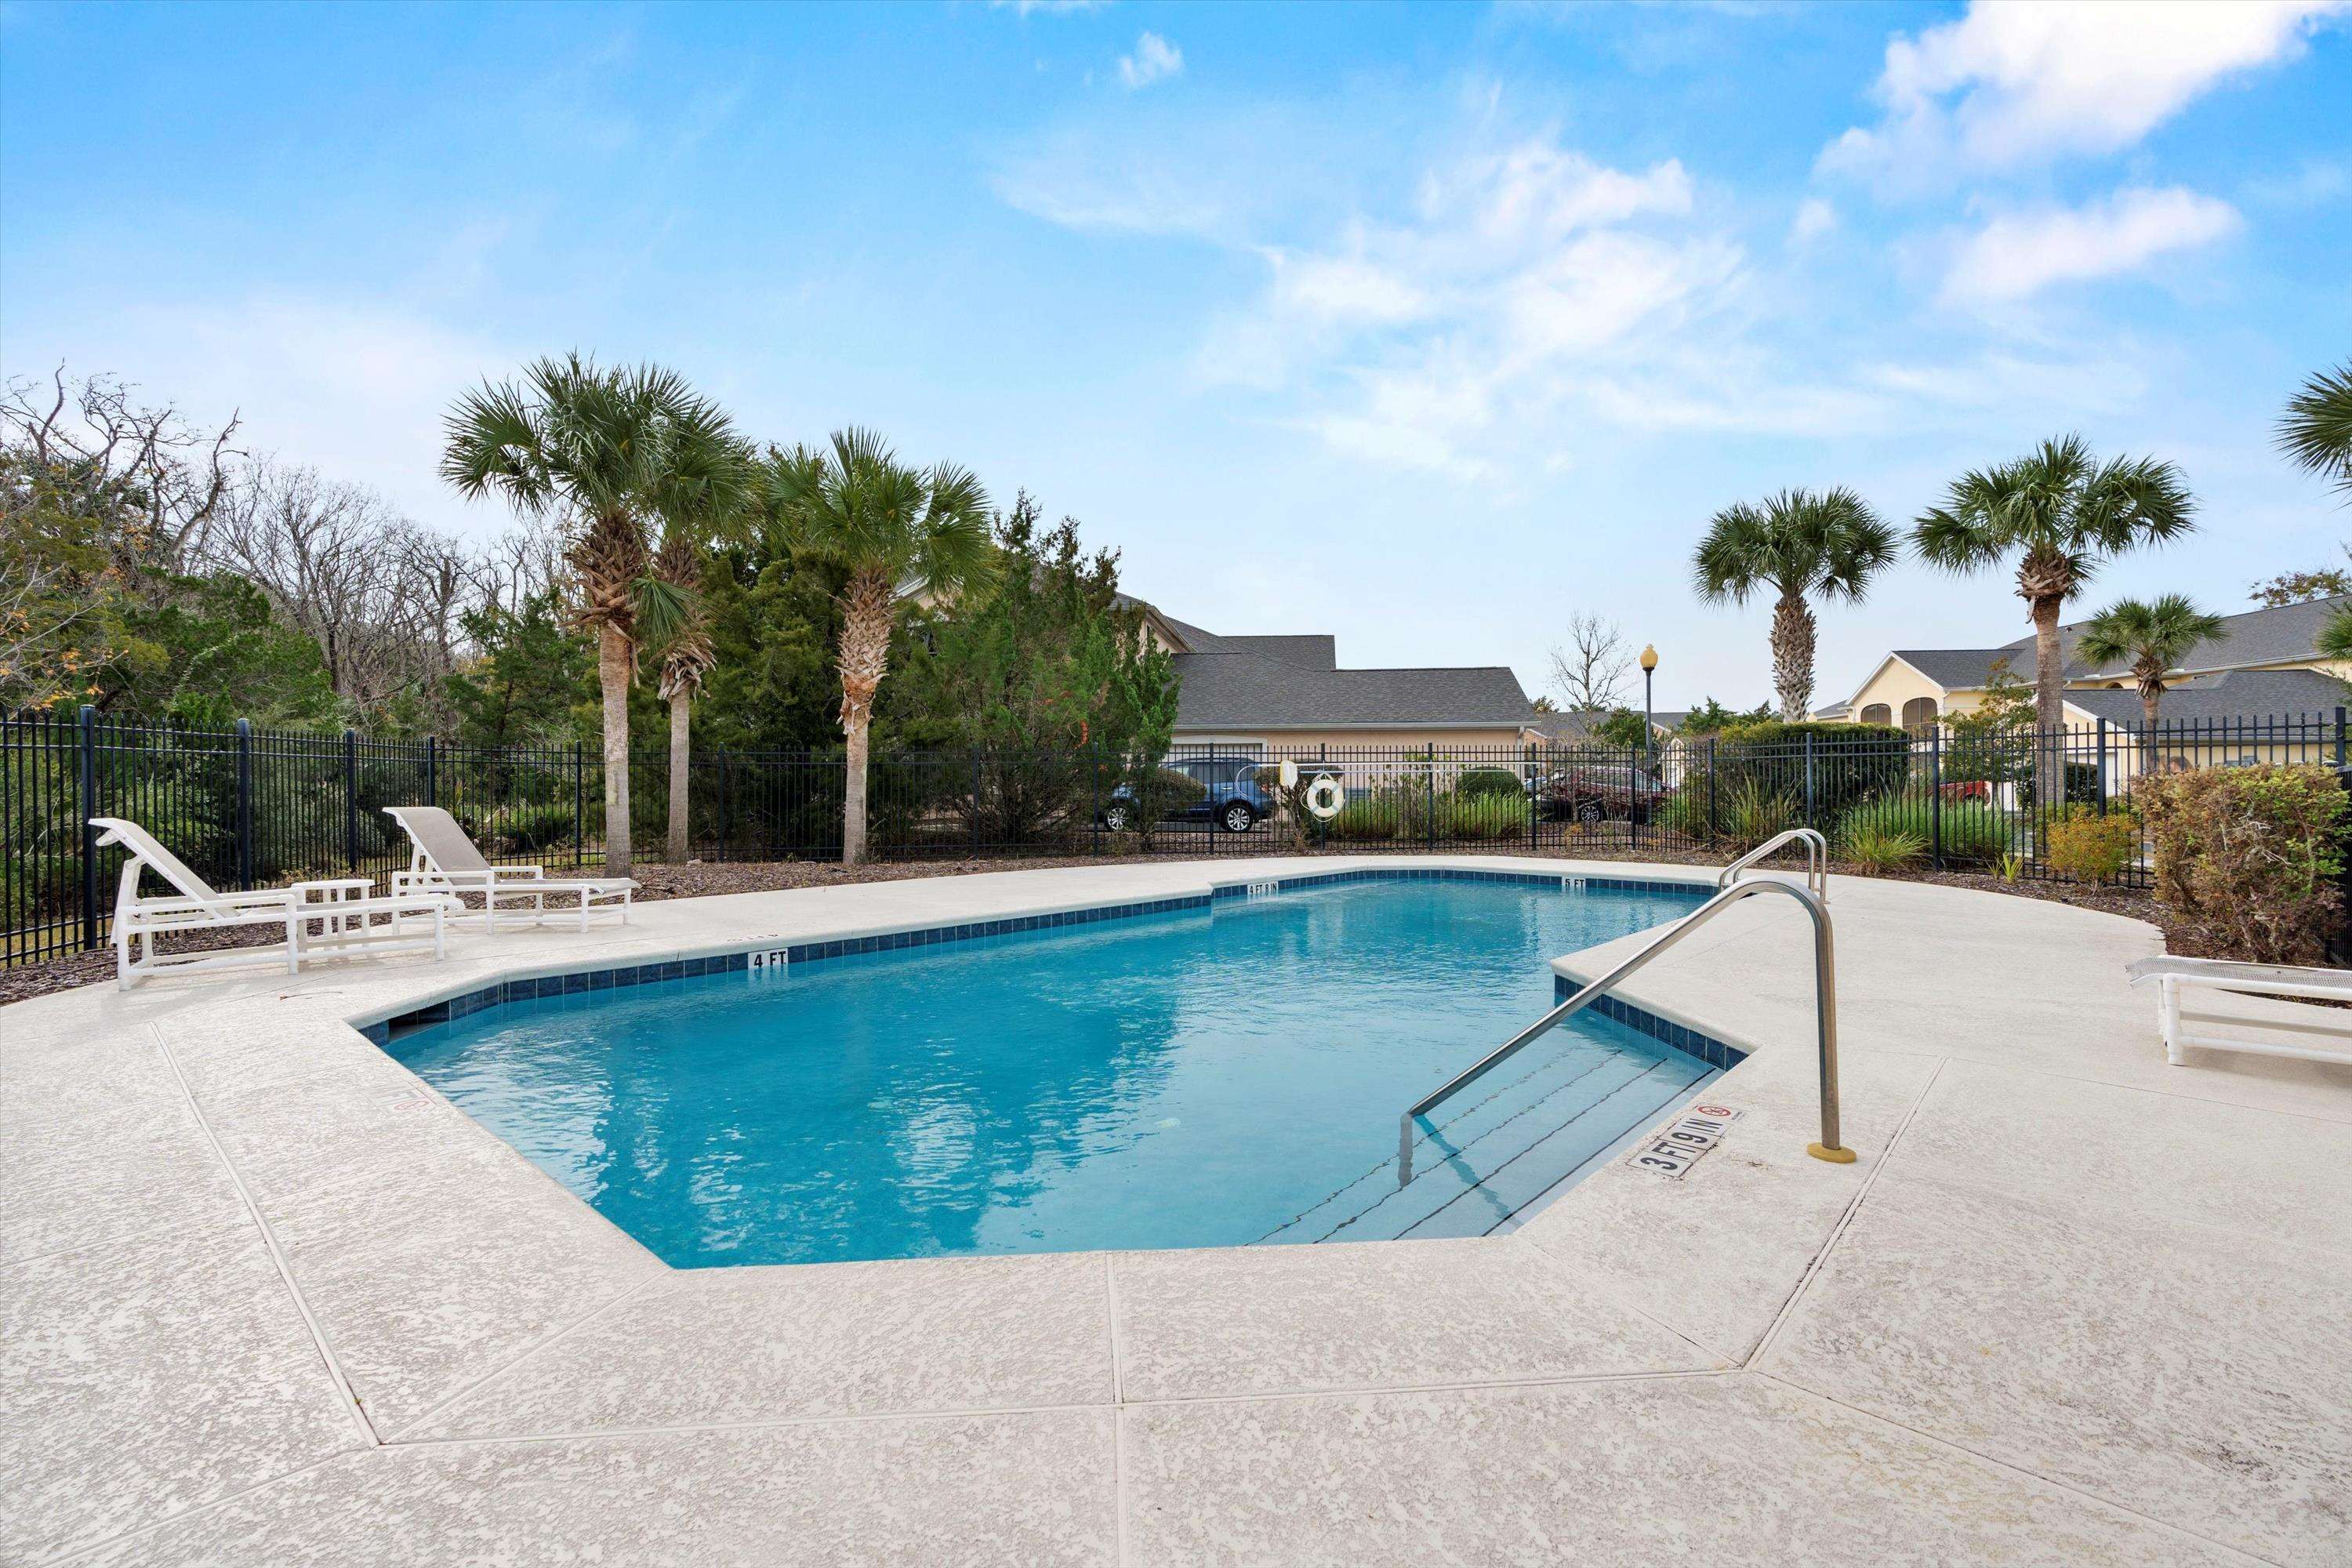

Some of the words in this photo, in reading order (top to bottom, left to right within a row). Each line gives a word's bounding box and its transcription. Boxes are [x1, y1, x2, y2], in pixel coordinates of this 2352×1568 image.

[1256, 884, 1262, 893] FT
[754, 954, 763, 967] 4
[1682, 1118, 1723, 1133] IN
[1671, 1132, 1708, 1143] 9
[1652, 1142, 1697, 1160] FT
[1640, 1157, 1678, 1170] 3
